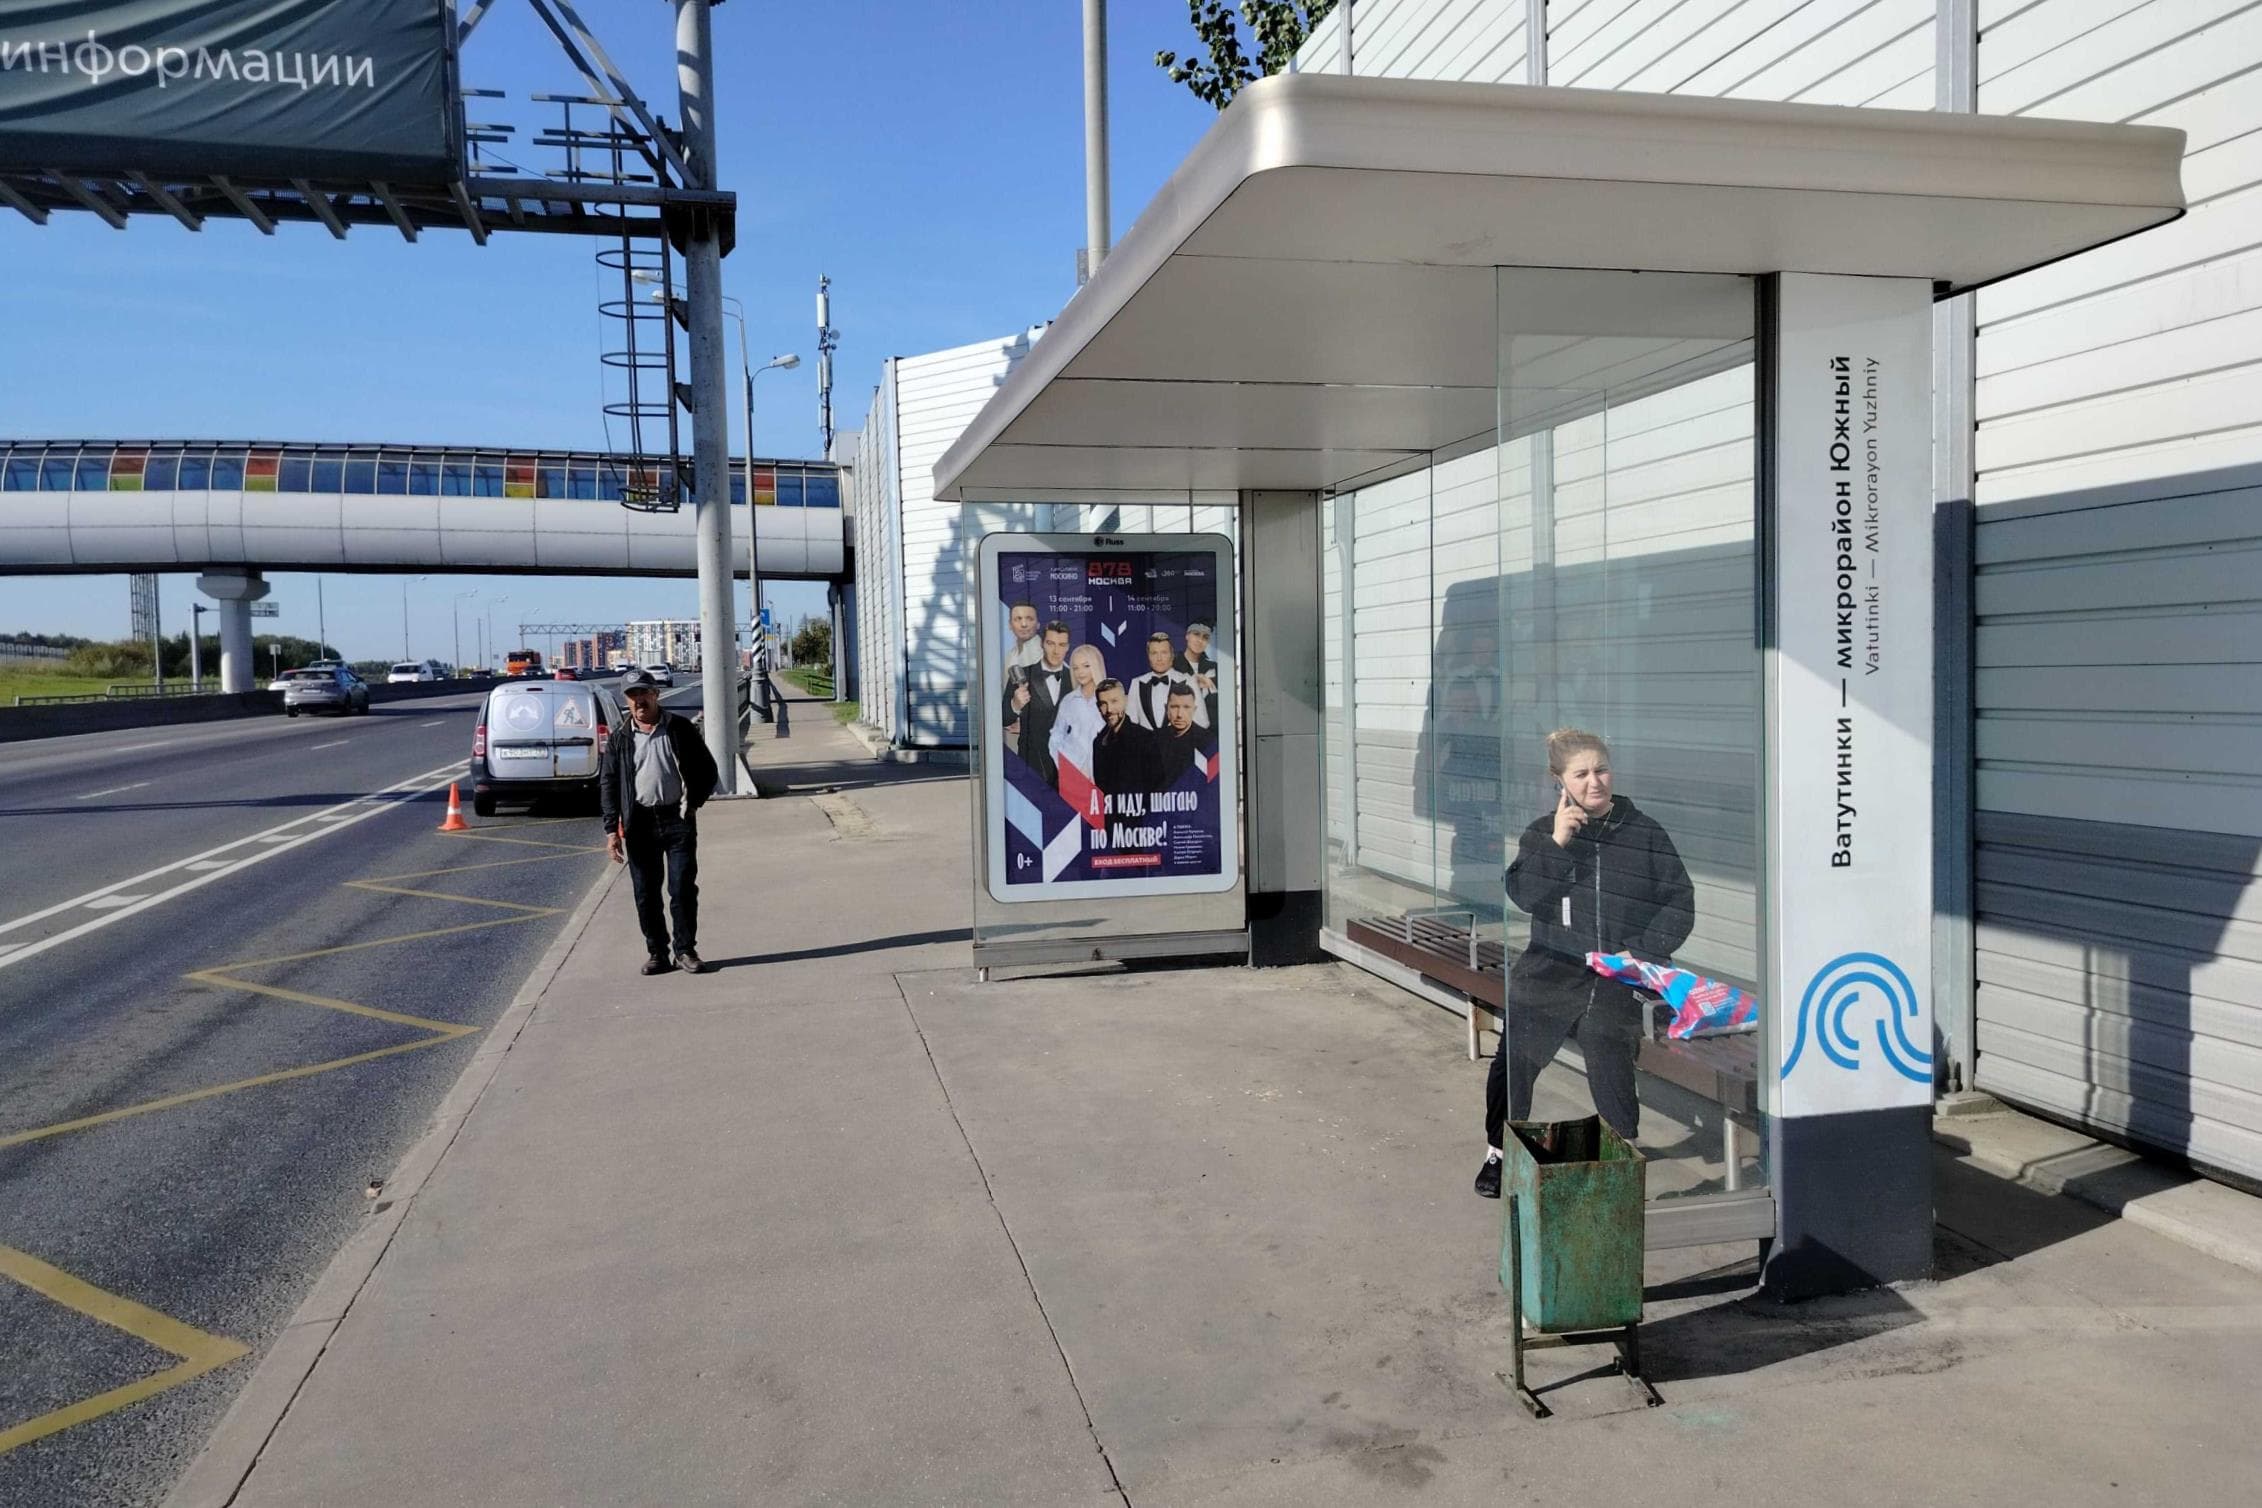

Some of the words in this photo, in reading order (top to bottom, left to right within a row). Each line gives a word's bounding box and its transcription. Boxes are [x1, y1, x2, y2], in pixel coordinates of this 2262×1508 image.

[1, 30, 375, 89] информации
[1830, 356, 1851, 471] Южный
[1863, 357, 1881, 433] Yuzhniy
[1865, 439, 1881, 553] Mikrorayon
[1105, 538, 1124, 546] Russ
[1058, 595, 1092, 603] сентября
[1088, 578, 1132, 586] МОСКВА
[1832, 481, 1857, 668] микрорайон
[1866, 584, 1880, 676] Vatutinki
[1089, 788, 1100, 815] А
[1103, 794, 1113, 814] я
[1117, 793, 1146, 816] иду,
[1150, 791, 1198, 812] шагаю
[1832, 718, 1857, 868] Ватутинки
[1017, 852, 1033, 870] 0+
[1090, 828, 1107, 849] по
[1112, 820, 1168, 848] Москве!
